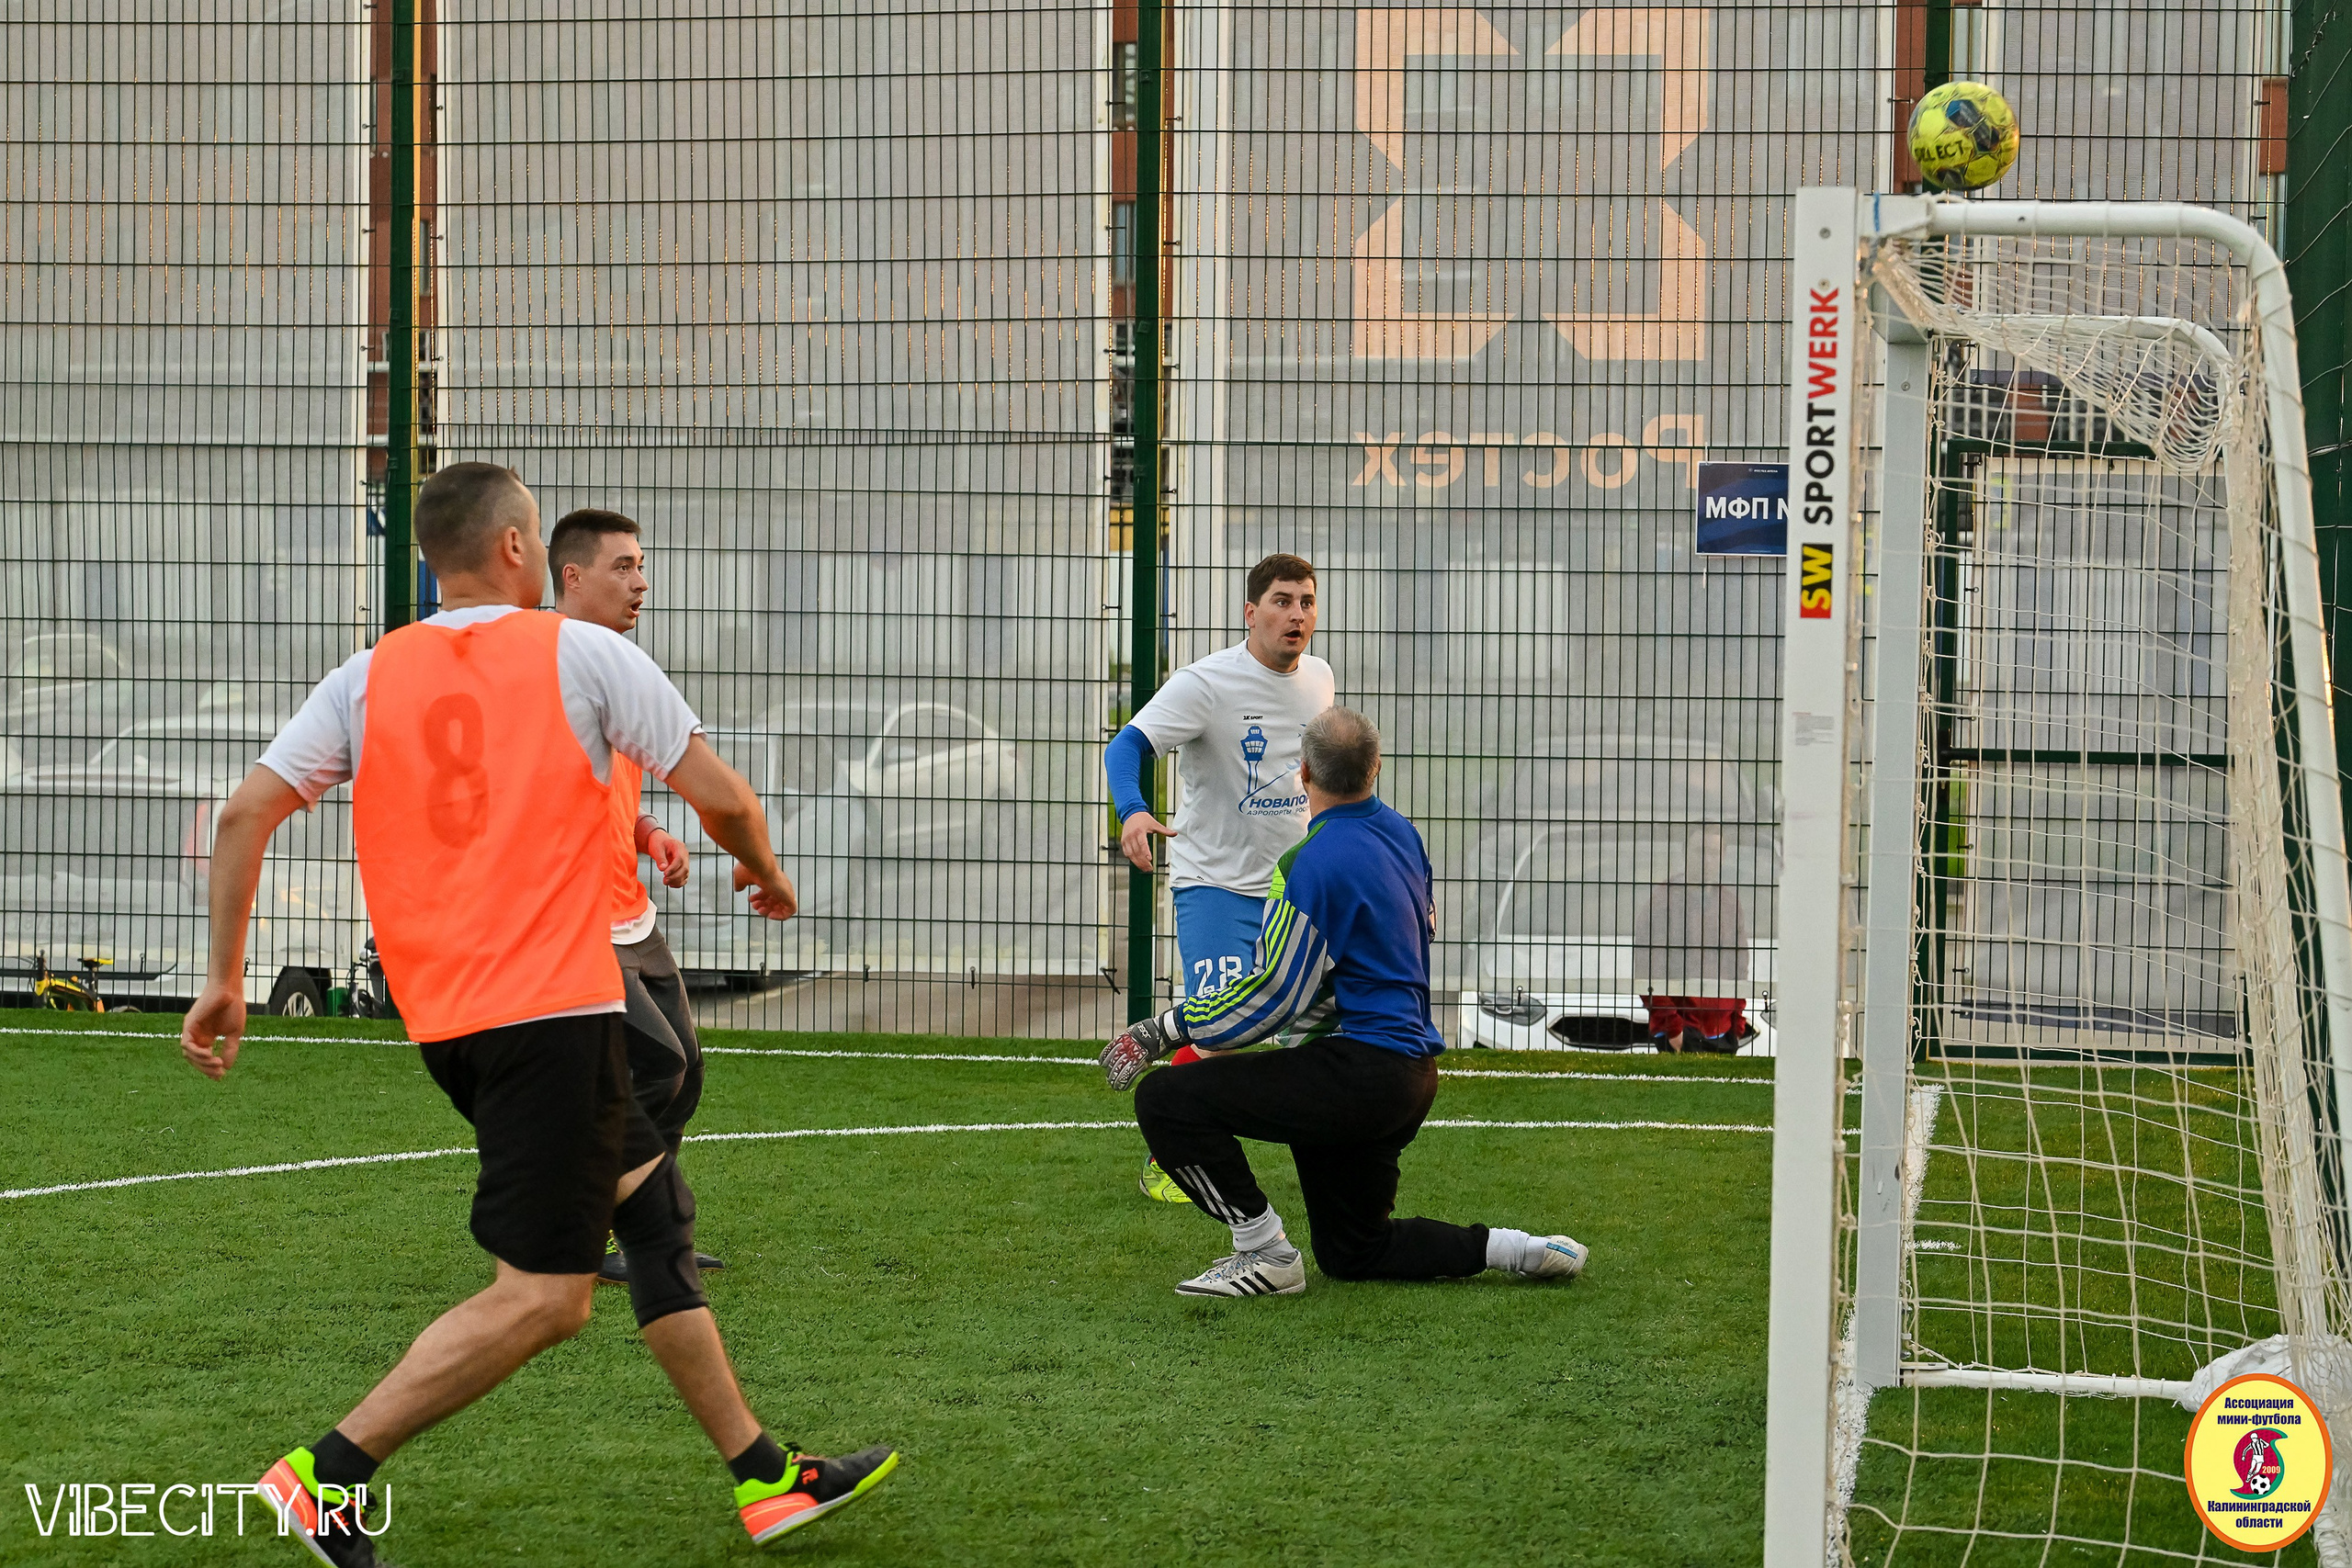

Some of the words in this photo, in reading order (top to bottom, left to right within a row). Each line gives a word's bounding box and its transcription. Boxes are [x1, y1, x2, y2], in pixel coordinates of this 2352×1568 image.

[1804, 287, 1839, 525] SPORTWERK
[1705, 496, 1770, 520] МФП
[1802, 545, 1833, 611] SW
[424, 693, 490, 850] 8
[1194, 955, 1243, 997] 28
